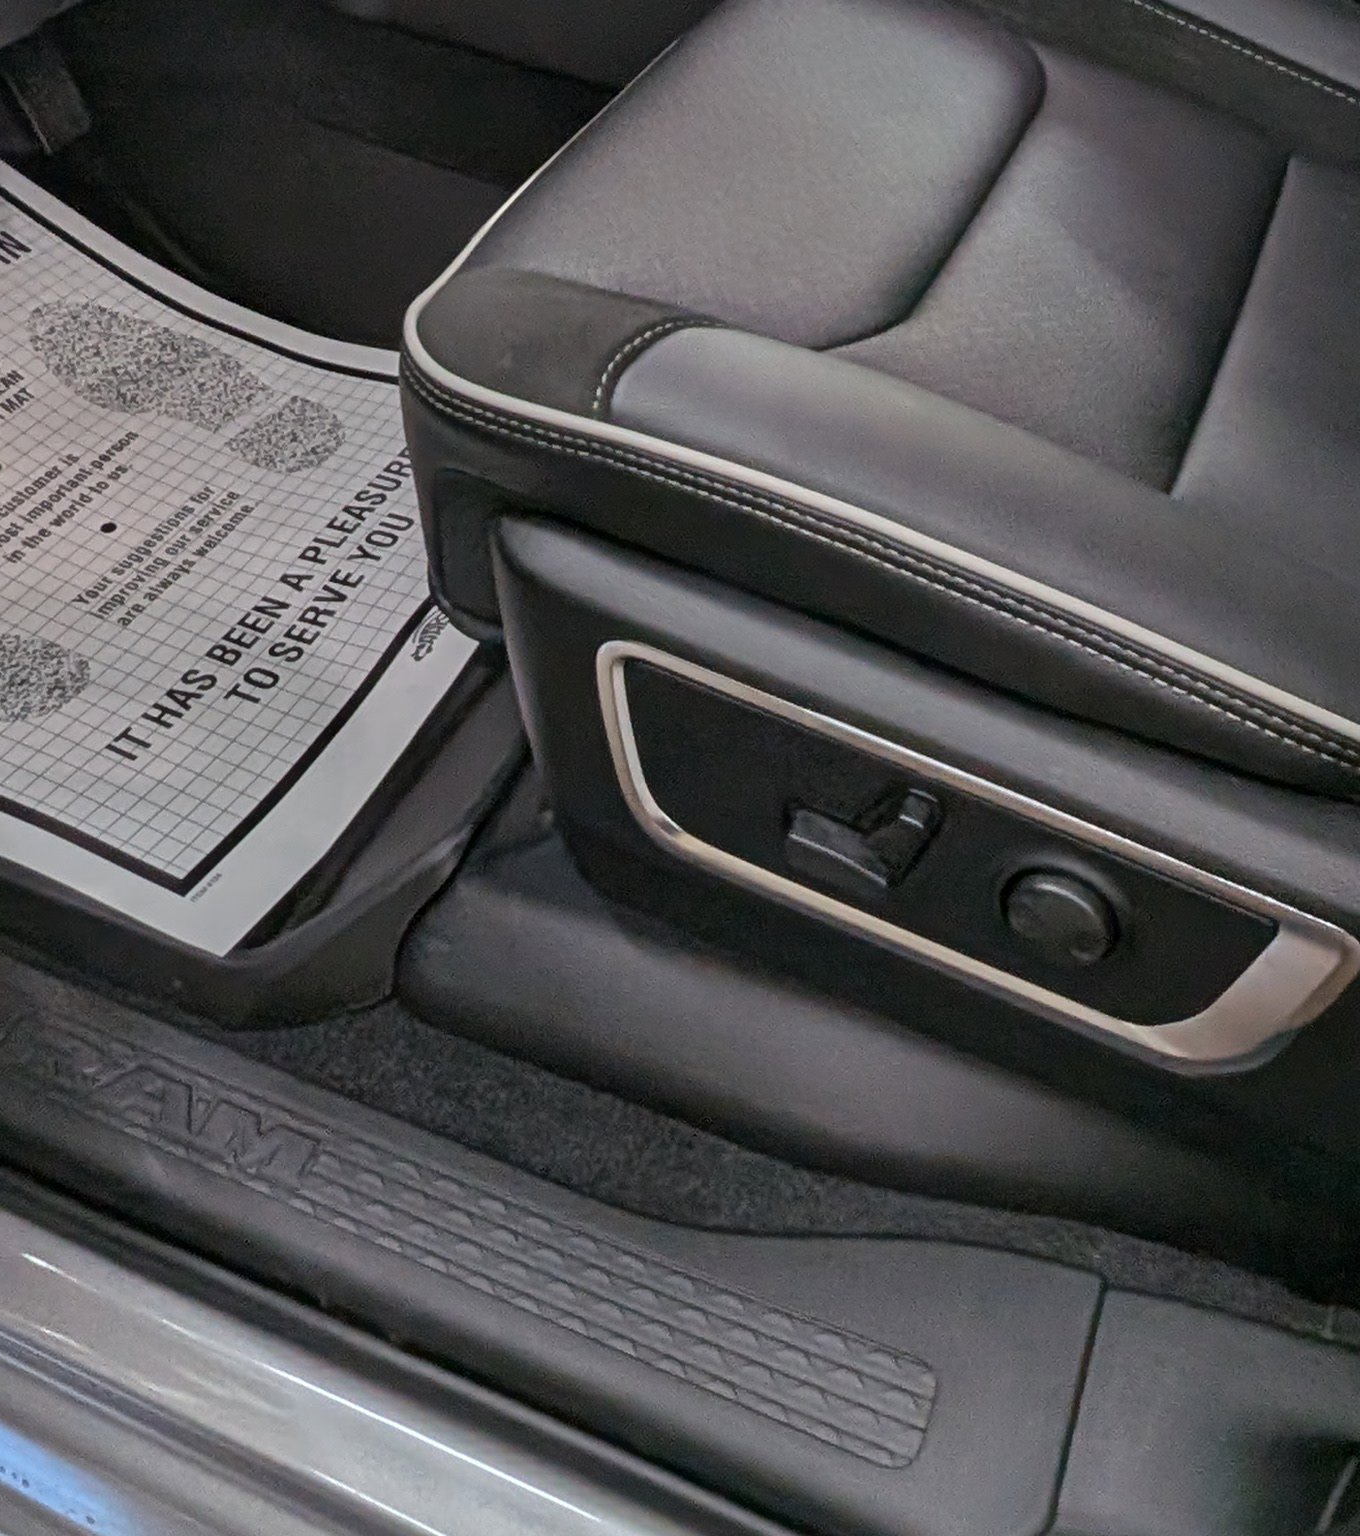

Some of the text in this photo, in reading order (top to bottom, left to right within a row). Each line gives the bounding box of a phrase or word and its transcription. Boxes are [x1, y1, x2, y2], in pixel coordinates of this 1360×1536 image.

[0, 386, 36, 414] MAT
[19, 467, 93, 524] important
[90, 430, 140, 471] person
[58, 453, 81, 466] is
[3, 549, 27, 564] in
[21, 526, 52, 549] the
[49, 491, 94, 528] world
[88, 480, 110, 495] to
[72, 485, 216, 605] Your suggestions for
[90, 490, 240, 620] improving our service
[116, 602, 147, 627] are
[143, 557, 197, 602] always
[223, 514, 416, 705] TO SERVE YOU
[105, 726, 152, 761] IT
[141, 668, 218, 730] HAS
[205, 595, 292, 667] BEEN
[279, 571, 315, 593] A
